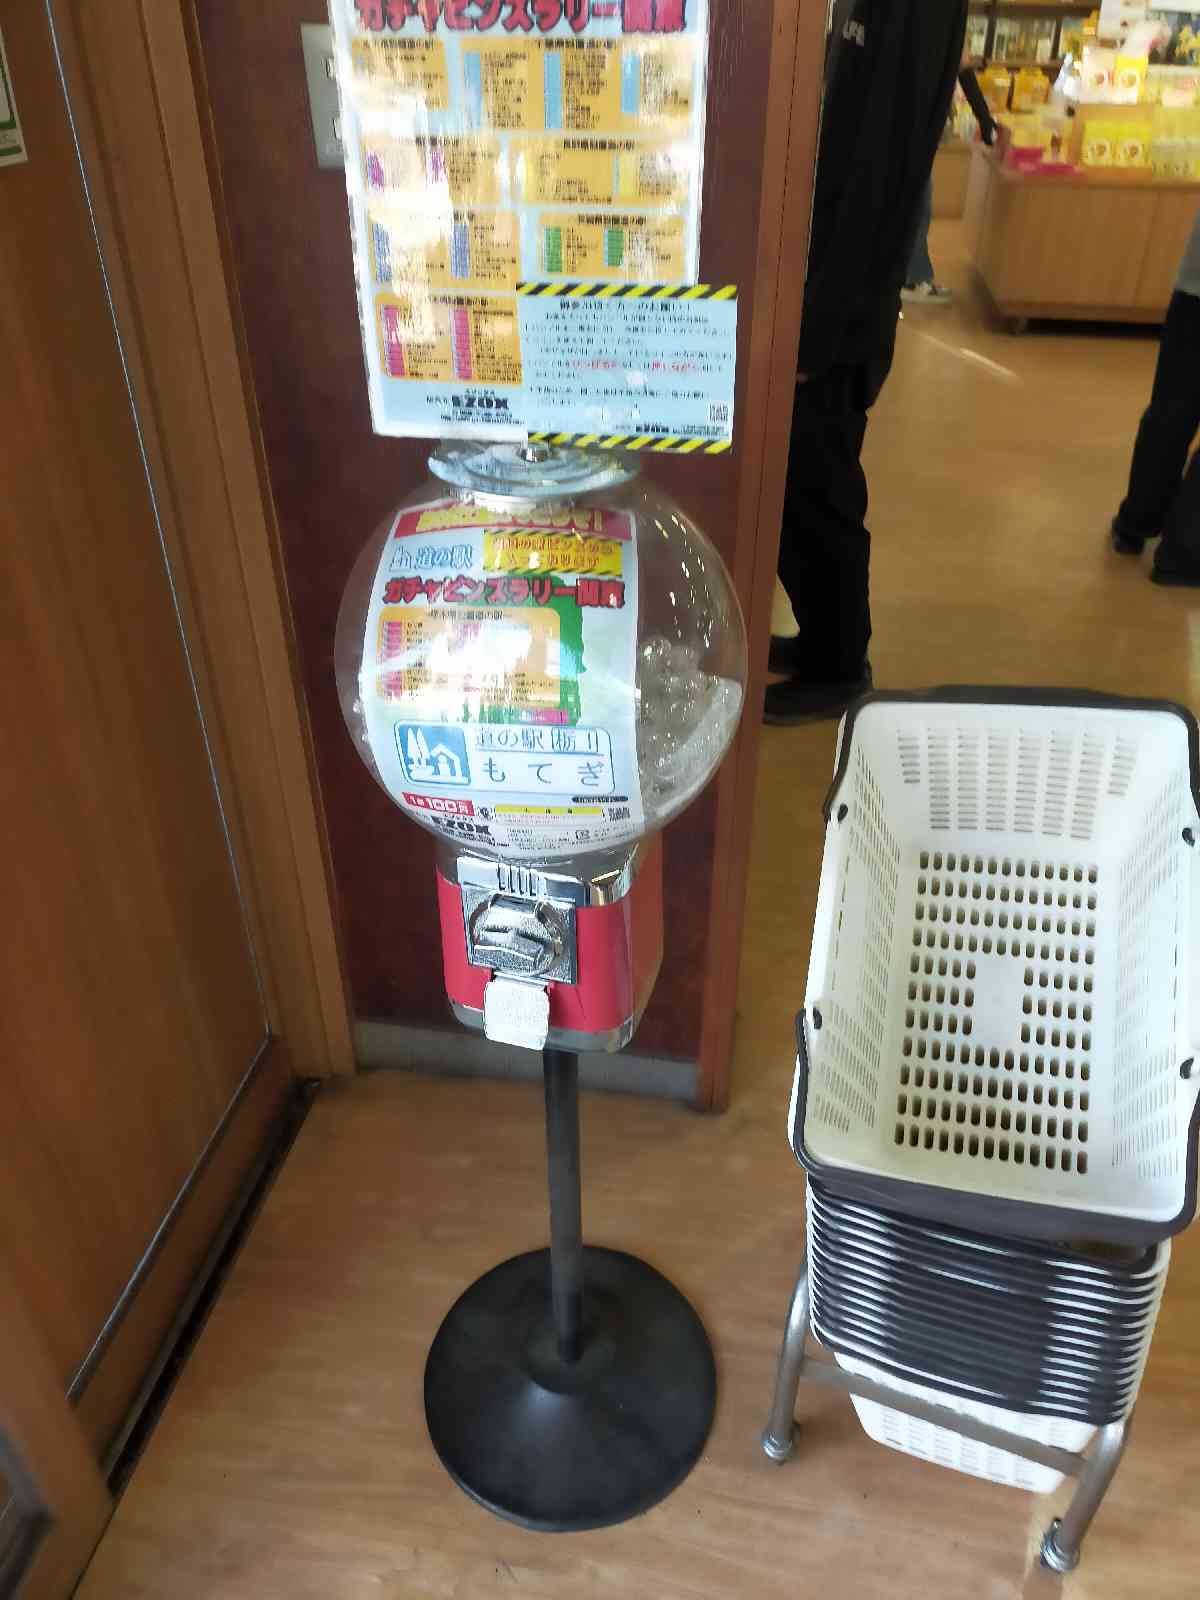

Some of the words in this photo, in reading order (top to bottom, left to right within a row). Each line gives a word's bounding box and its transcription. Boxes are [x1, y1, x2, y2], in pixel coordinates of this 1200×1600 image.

[476, 727, 544, 751] 道の駅
[483, 757, 605, 786] もてぎ
